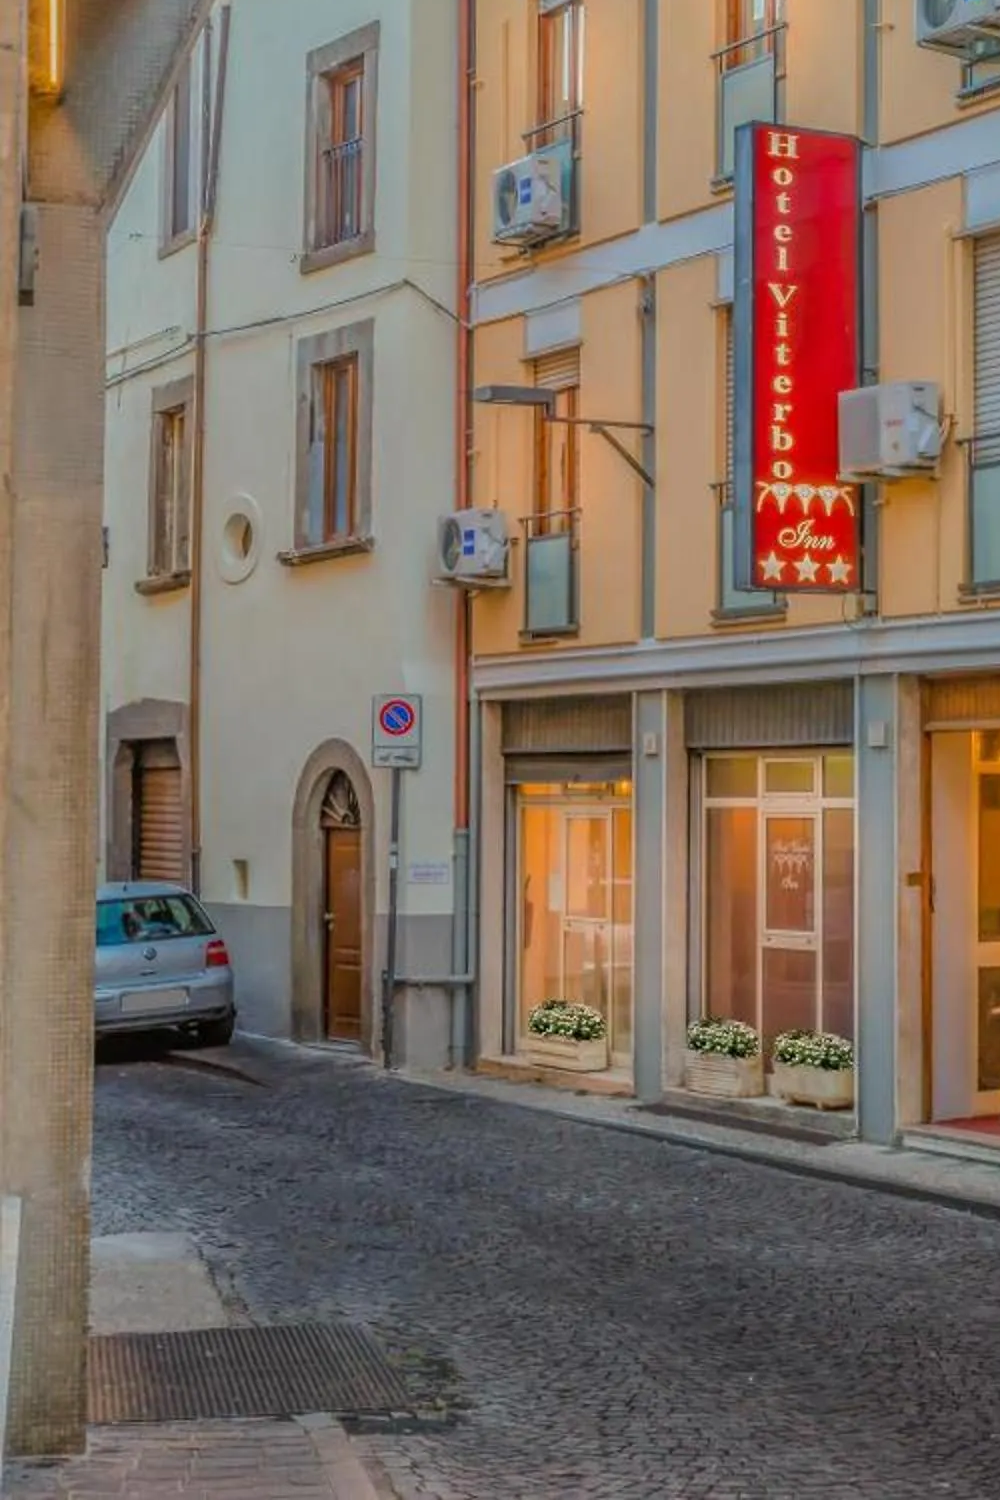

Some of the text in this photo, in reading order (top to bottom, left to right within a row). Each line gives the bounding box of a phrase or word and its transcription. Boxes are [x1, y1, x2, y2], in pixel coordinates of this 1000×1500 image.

[767, 131, 800, 479] Hotel Viterbo
[778, 518, 836, 550] Inn
